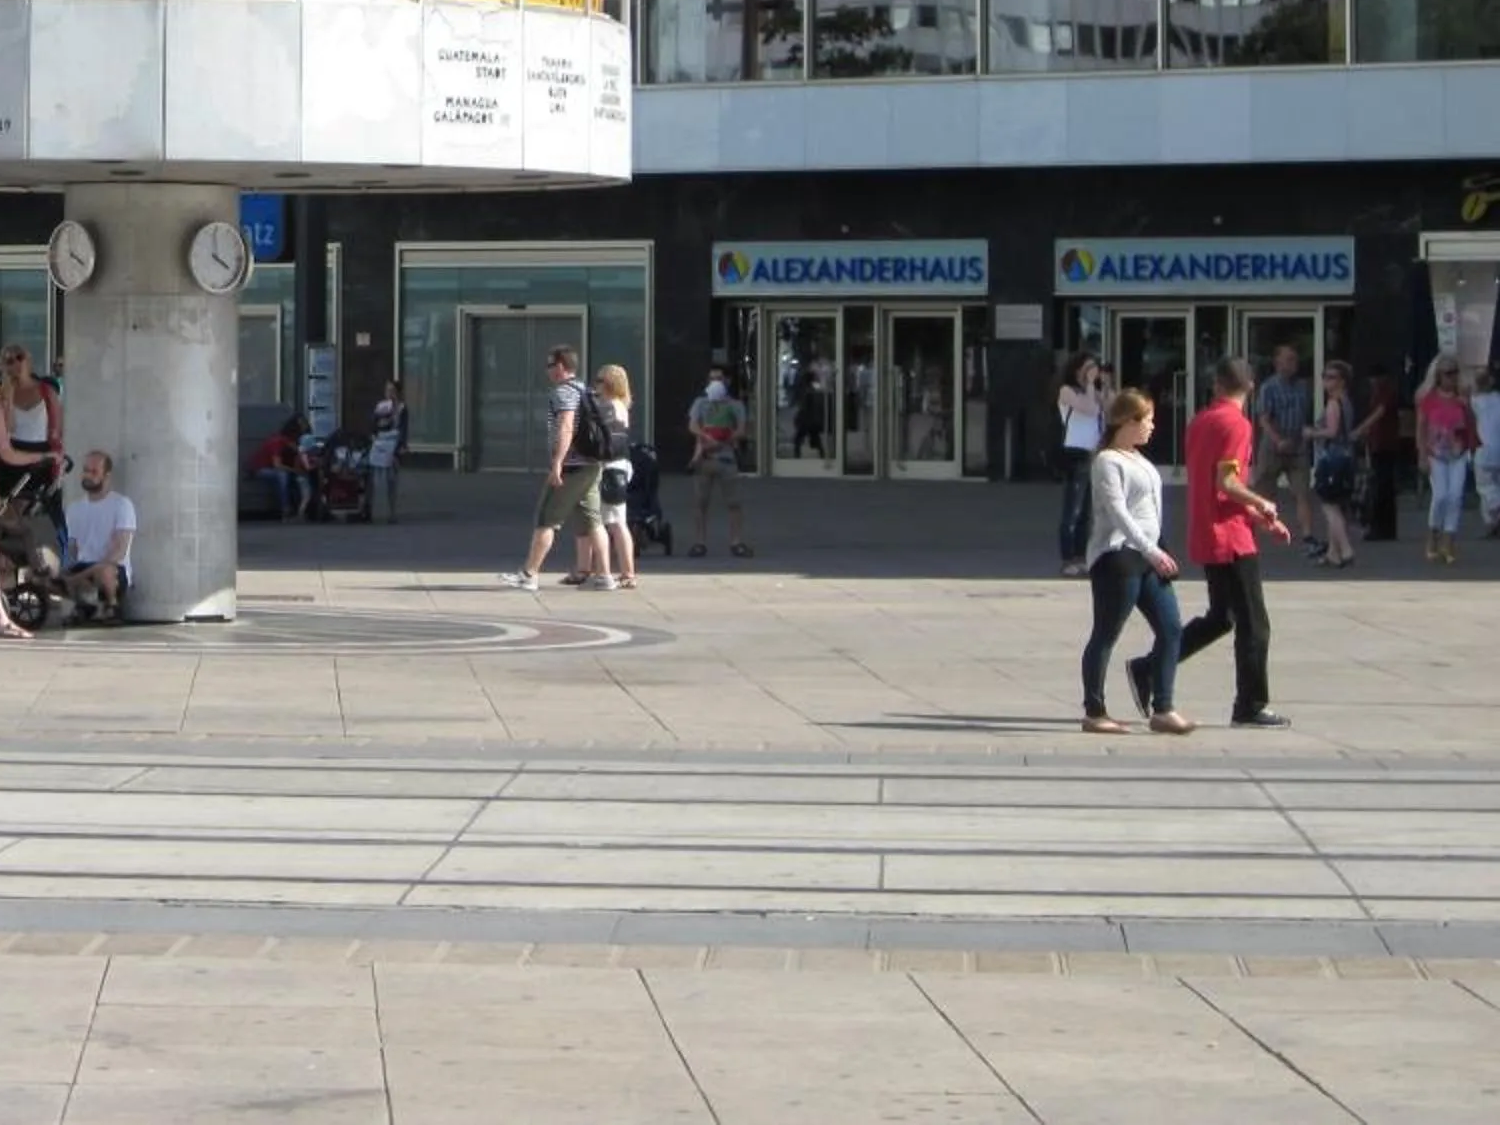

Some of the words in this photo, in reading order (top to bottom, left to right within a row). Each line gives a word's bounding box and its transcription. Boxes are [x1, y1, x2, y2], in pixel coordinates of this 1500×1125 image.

[476, 66, 506, 81] STADT
[445, 96, 499, 109] MANAGUA
[752, 256, 982, 283] ALEXANDERHAUS
[1100, 252, 1348, 281] ALEXANDERHAUS
